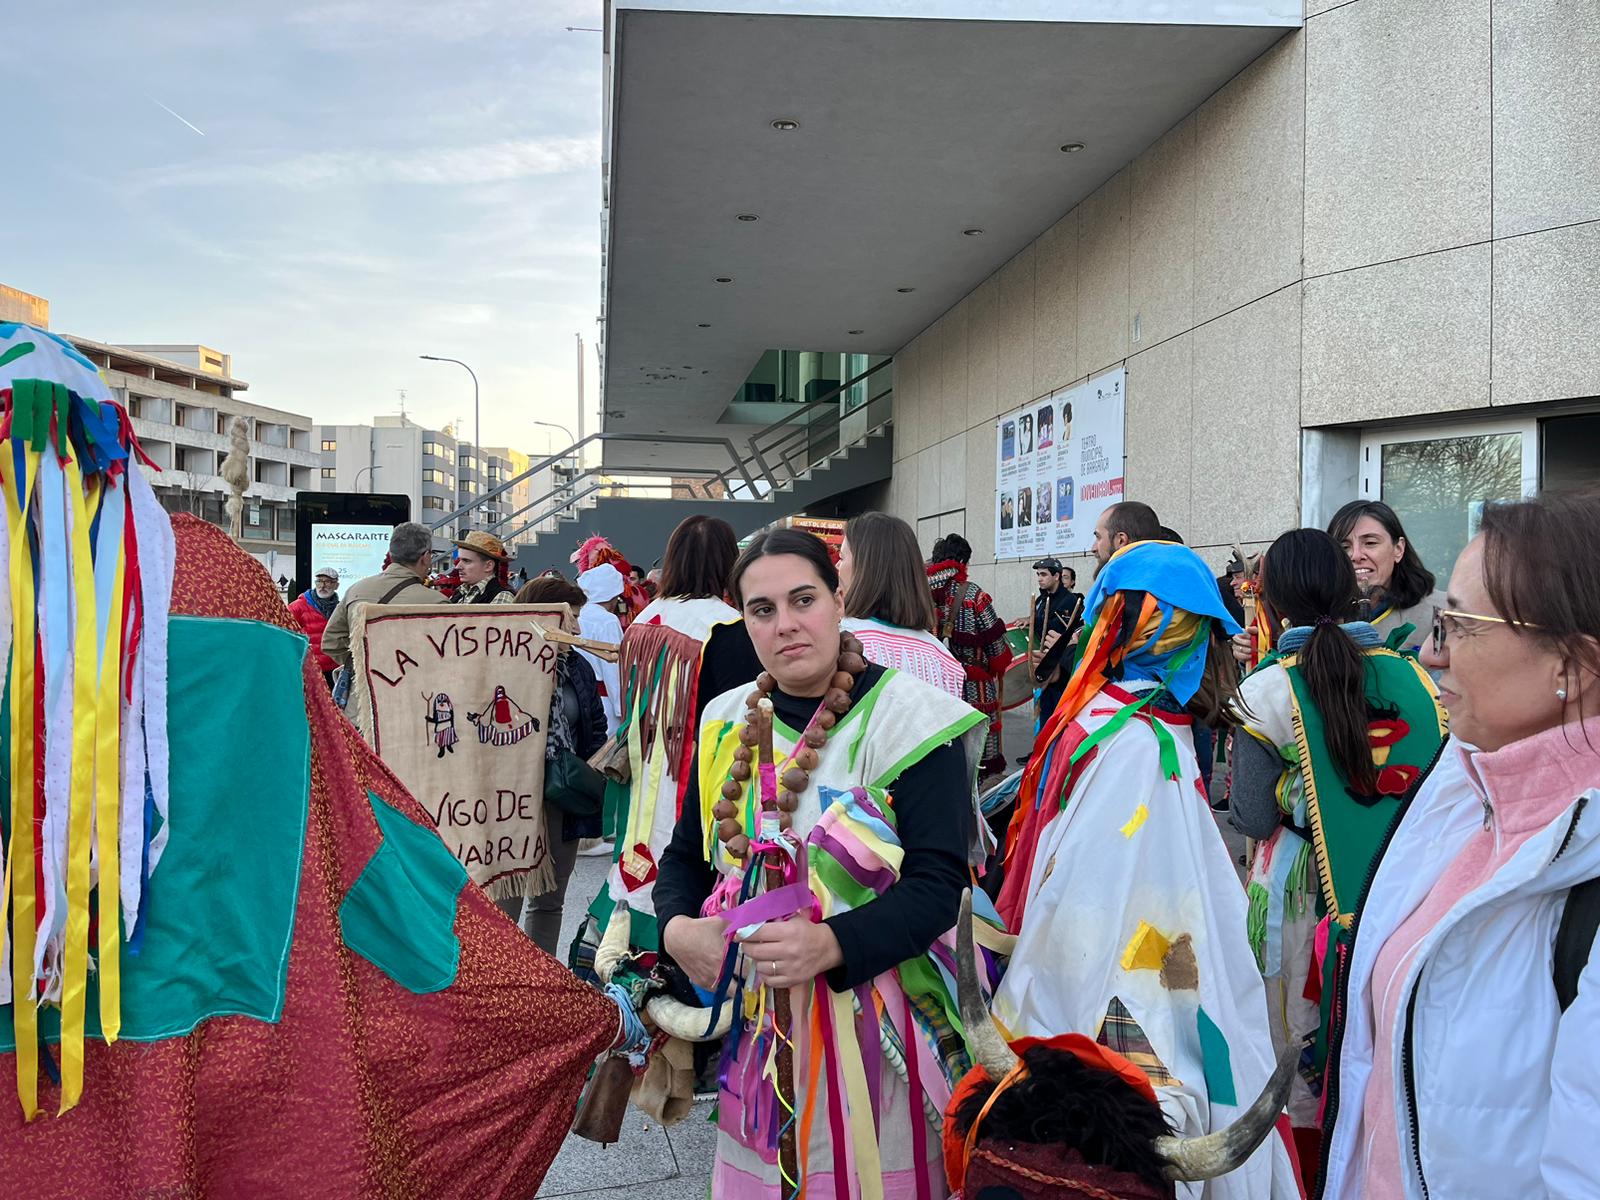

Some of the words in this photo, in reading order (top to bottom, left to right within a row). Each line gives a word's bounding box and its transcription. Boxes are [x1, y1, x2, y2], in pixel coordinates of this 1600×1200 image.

[316, 532, 390, 541] MASCARARTE
[371, 650, 419, 687] LA
[495, 790, 533, 822] DE
